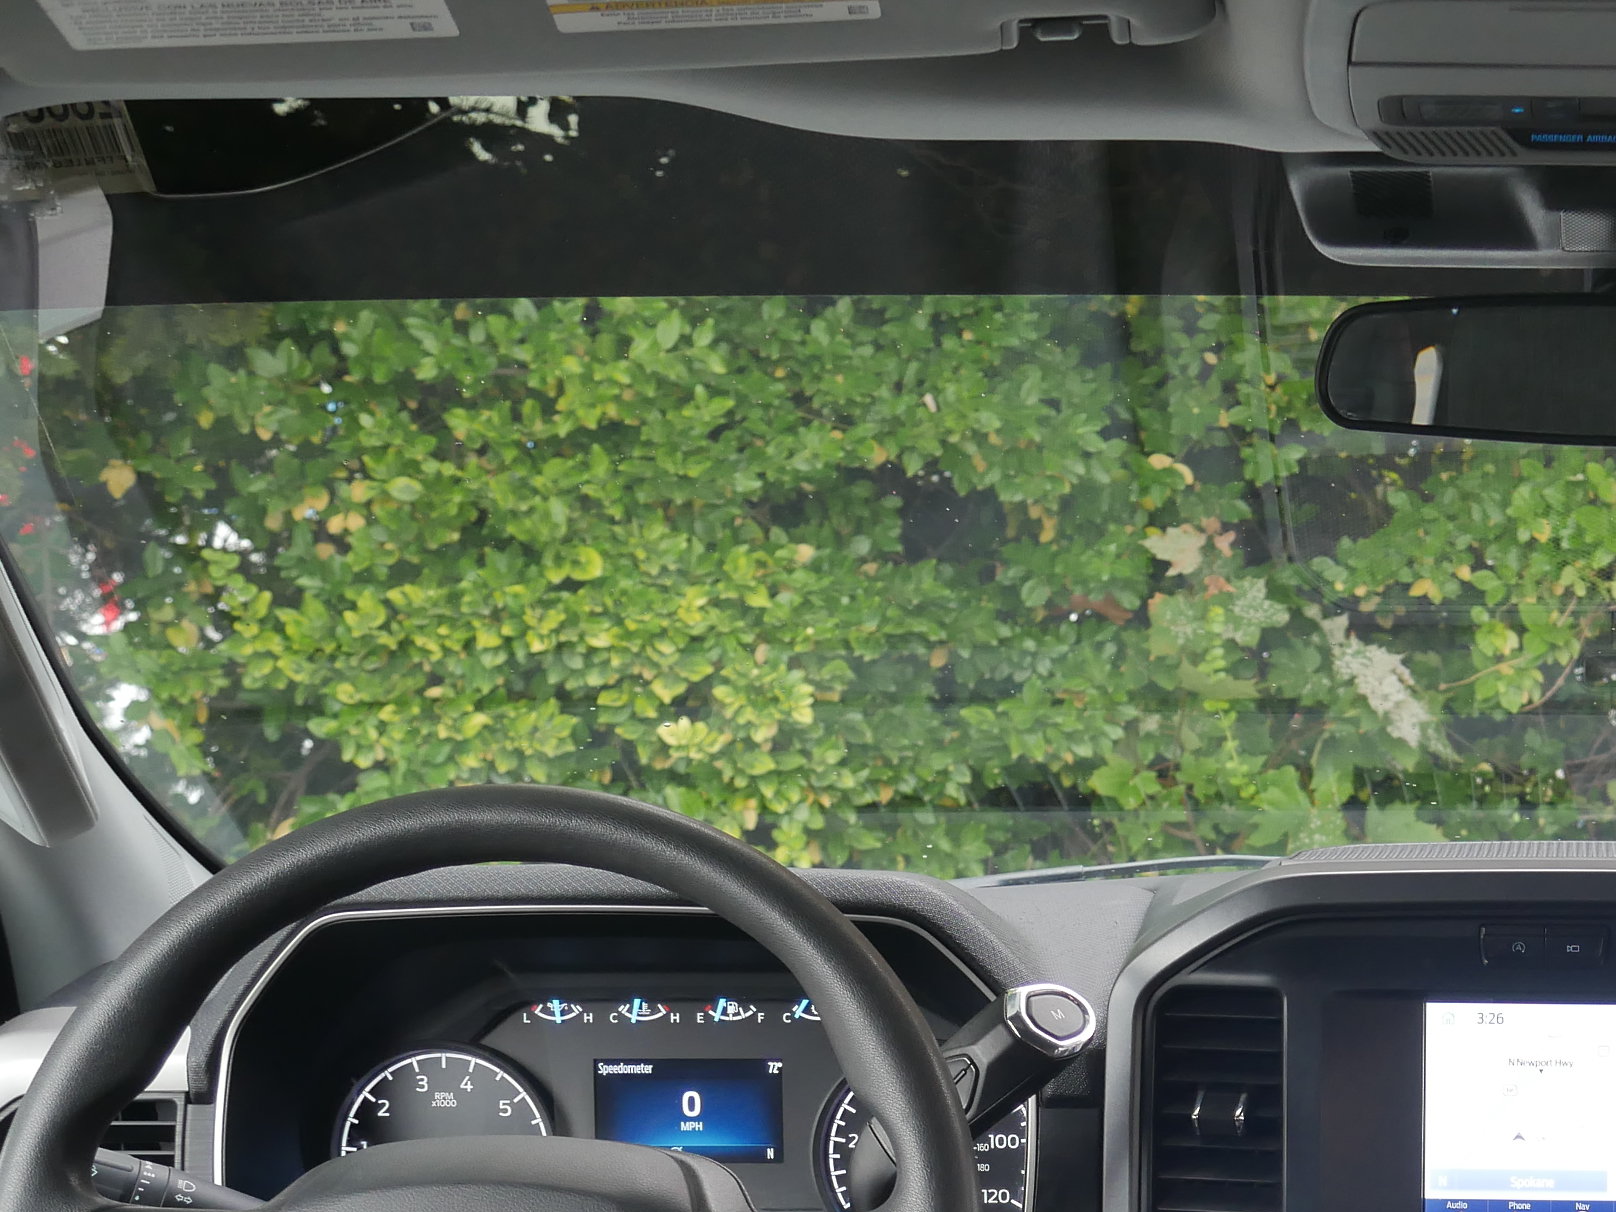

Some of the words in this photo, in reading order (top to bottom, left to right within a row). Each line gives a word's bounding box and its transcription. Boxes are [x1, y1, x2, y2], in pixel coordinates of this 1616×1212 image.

[1531, 134, 1583, 143] PASSENGER
[523, 1012, 531, 1024] L
[583, 1012, 593, 1024] H
[609, 1012, 619, 1024] C
[670, 1012, 680, 1024] H
[697, 1012, 704, 1024] E
[757, 1012, 765, 1024] F
[782, 1012, 792, 1024] C
[1476, 1012, 1505, 1026] 3:26
[597, 1062, 653, 1076] Speedometer
[415, 1075, 429, 1092] 3
[460, 1075, 474, 1092] 4
[434, 1092, 454, 1100] RPM
[377, 1100, 390, 1117] 2
[431, 1099, 457, 1108] x1000
[498, 1100, 512, 1117] 5
[681, 1090, 701, 1117] 0
[680, 1121, 703, 1132] MPH
[848, 1133, 859, 1149] 2
[988, 1133, 1020, 1149] 100
[766, 1147, 774, 1159] N
[977, 1163, 990, 1172] 180
[1509, 1176, 1555, 1189] Spokane
[981, 1189, 1010, 1204] 120
[1446, 1201, 1468, 1209] Audio
[1508, 1201, 1531, 1210] Phone
[1575, 1202, 1590, 1211] Nav
